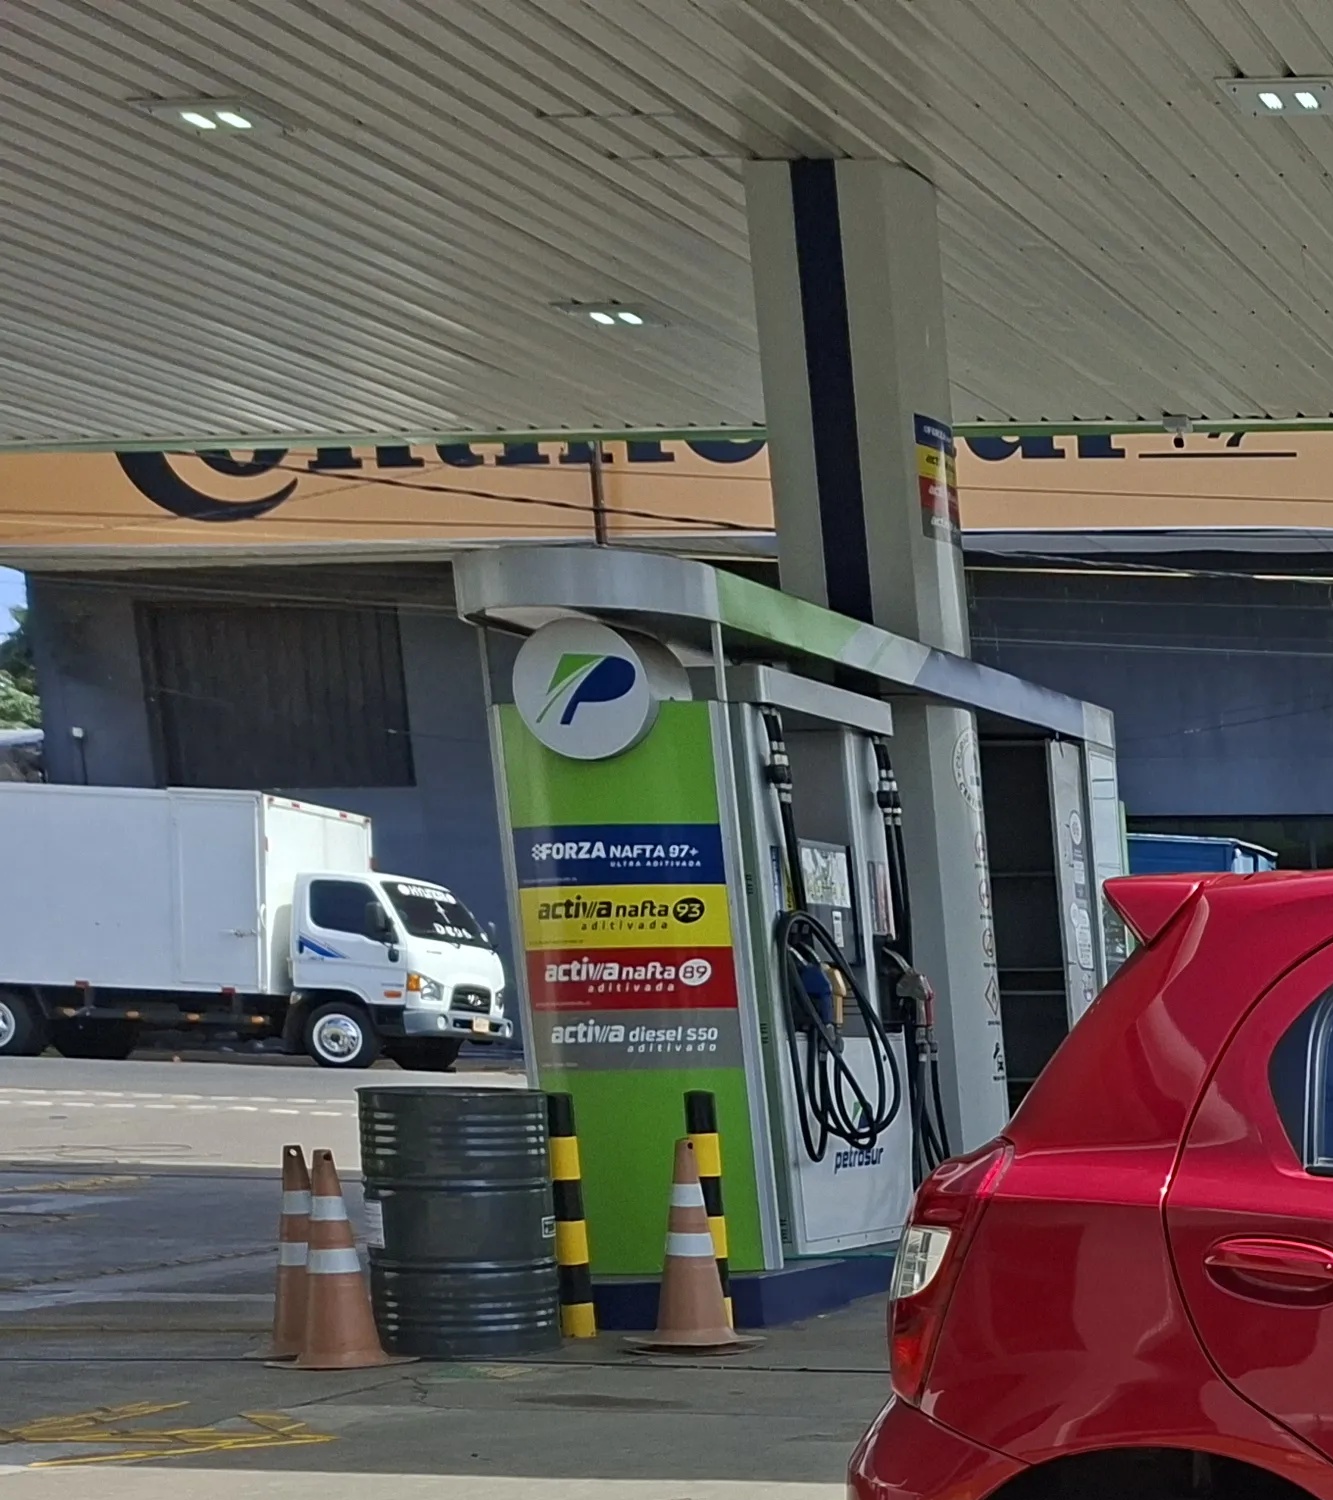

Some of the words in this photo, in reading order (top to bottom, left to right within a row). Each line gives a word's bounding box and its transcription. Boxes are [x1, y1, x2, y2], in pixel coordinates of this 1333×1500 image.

[541, 841, 607, 860] FORZA
[610, 845, 665, 859] NAFTA
[669, 845, 699, 858] 97+
[538, 895, 613, 920] activa
[615, 900, 669, 918] nafta
[674, 902, 702, 919] 93
[581, 920, 668, 930] aditivada
[545, 956, 618, 982] activa
[622, 961, 675, 980] nafta
[681, 964, 708, 980] 89
[588, 983, 675, 993] aditivada
[551, 1019, 625, 1044] activa
[629, 1026, 682, 1042] diesel
[686, 1027, 718, 1041] S50
[627, 1043, 717, 1053] aditivado
[834, 1146, 884, 1175] petrosur
